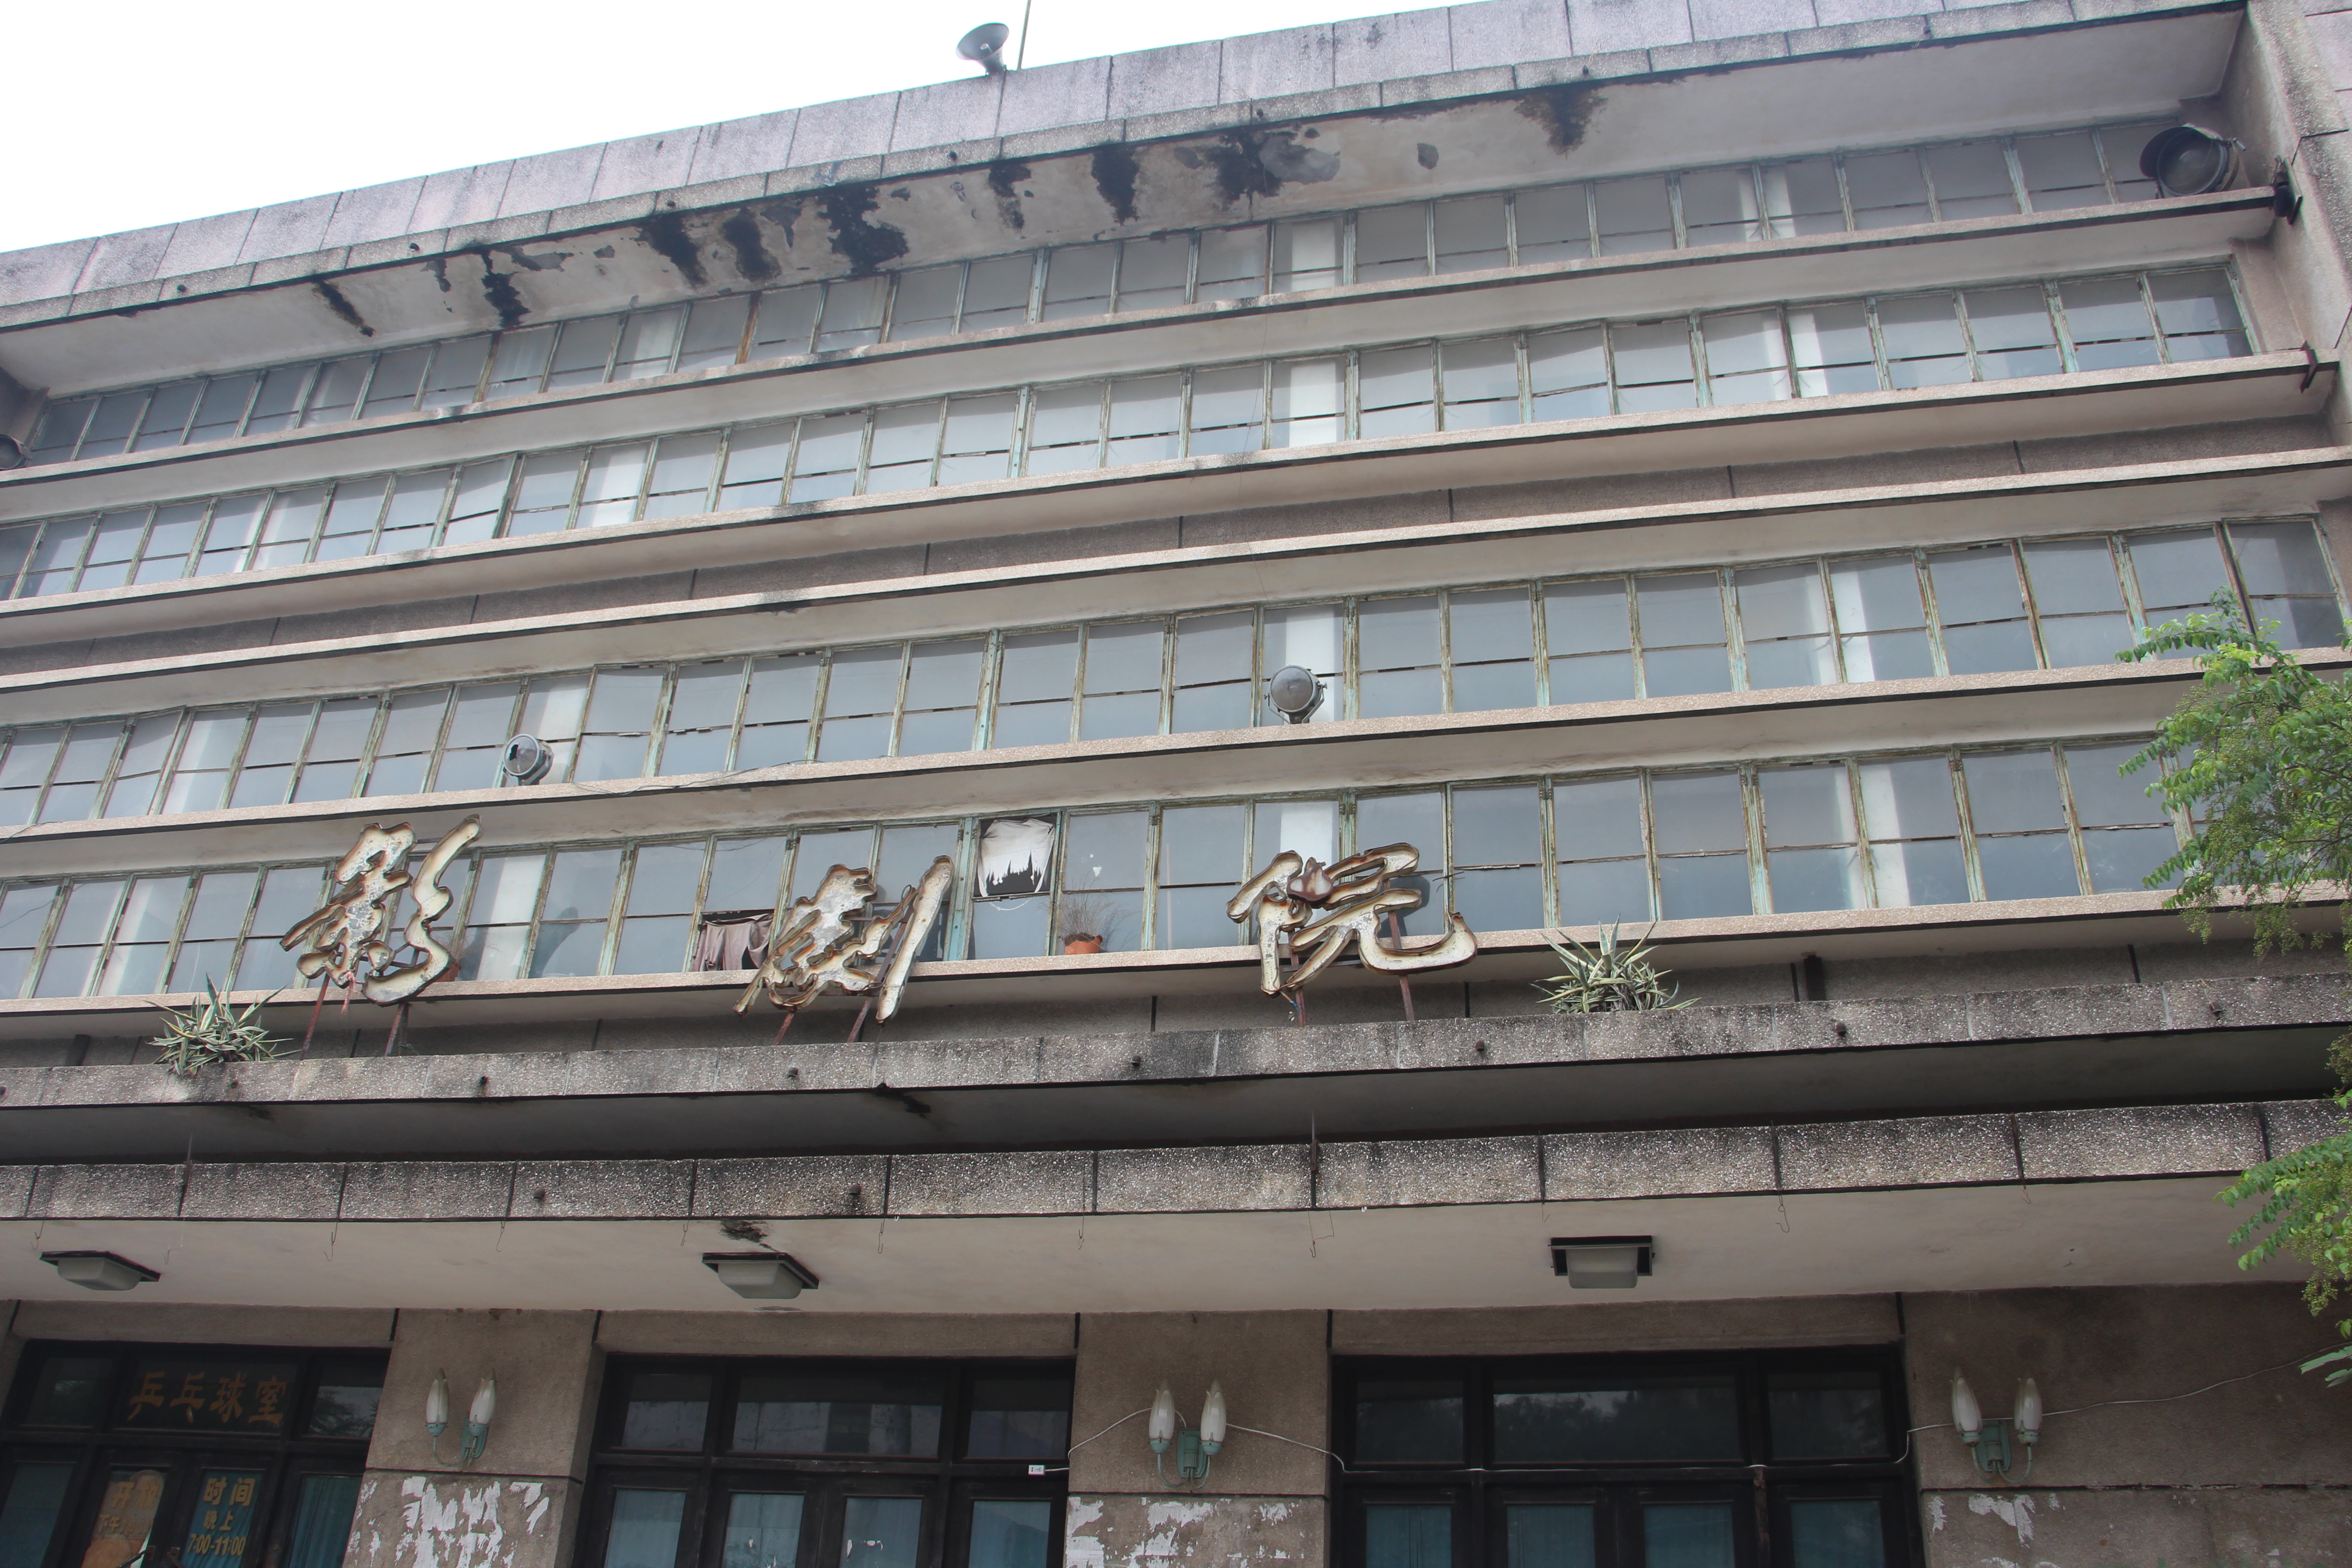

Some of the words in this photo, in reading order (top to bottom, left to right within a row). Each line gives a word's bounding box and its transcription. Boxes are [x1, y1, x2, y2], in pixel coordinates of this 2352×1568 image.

[127, 1371, 287, 1425] 乒乓球室
[111, 1481, 160, 1509] 开放
[202, 1477, 256, 1506] 时间
[203, 1510, 234, 1531] 晚上
[187, 1533, 246, 1557] 7:00-11:00
